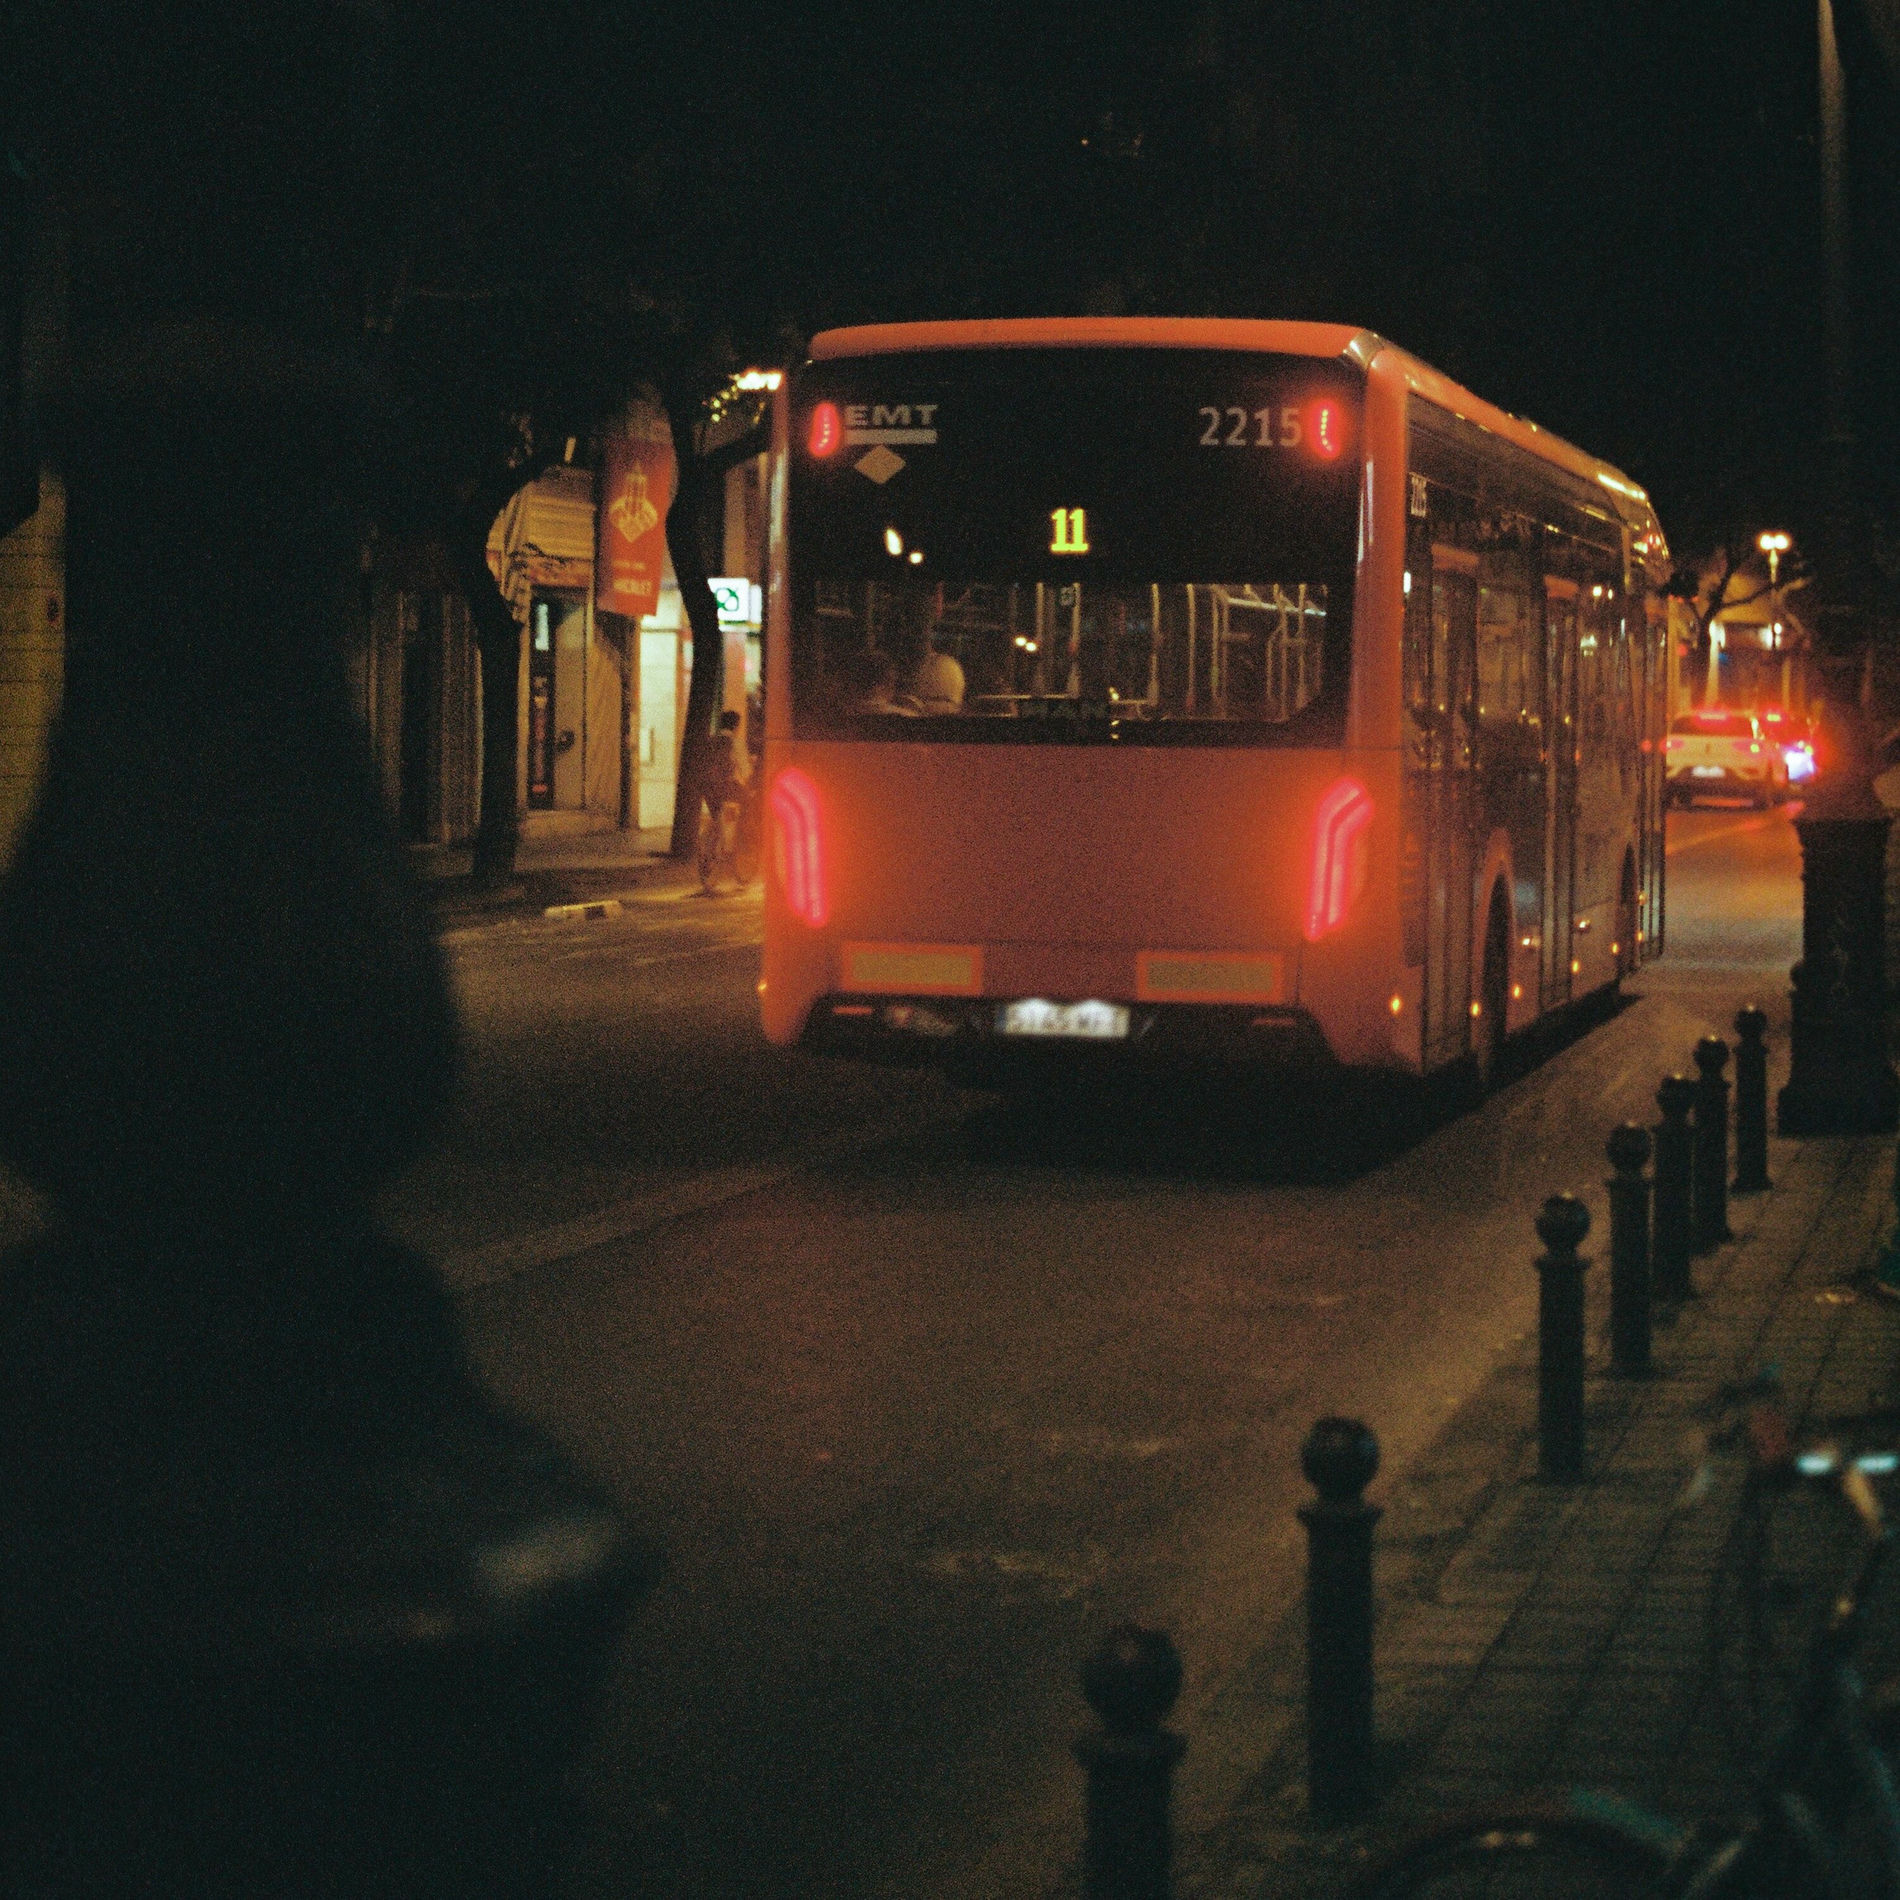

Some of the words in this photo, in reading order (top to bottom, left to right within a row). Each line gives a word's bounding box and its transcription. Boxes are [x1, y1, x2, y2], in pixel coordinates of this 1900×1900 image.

[844, 404, 939, 426] EMT
[1199, 406, 1302, 447] 2215
[1051, 508, 1089, 552] 11
